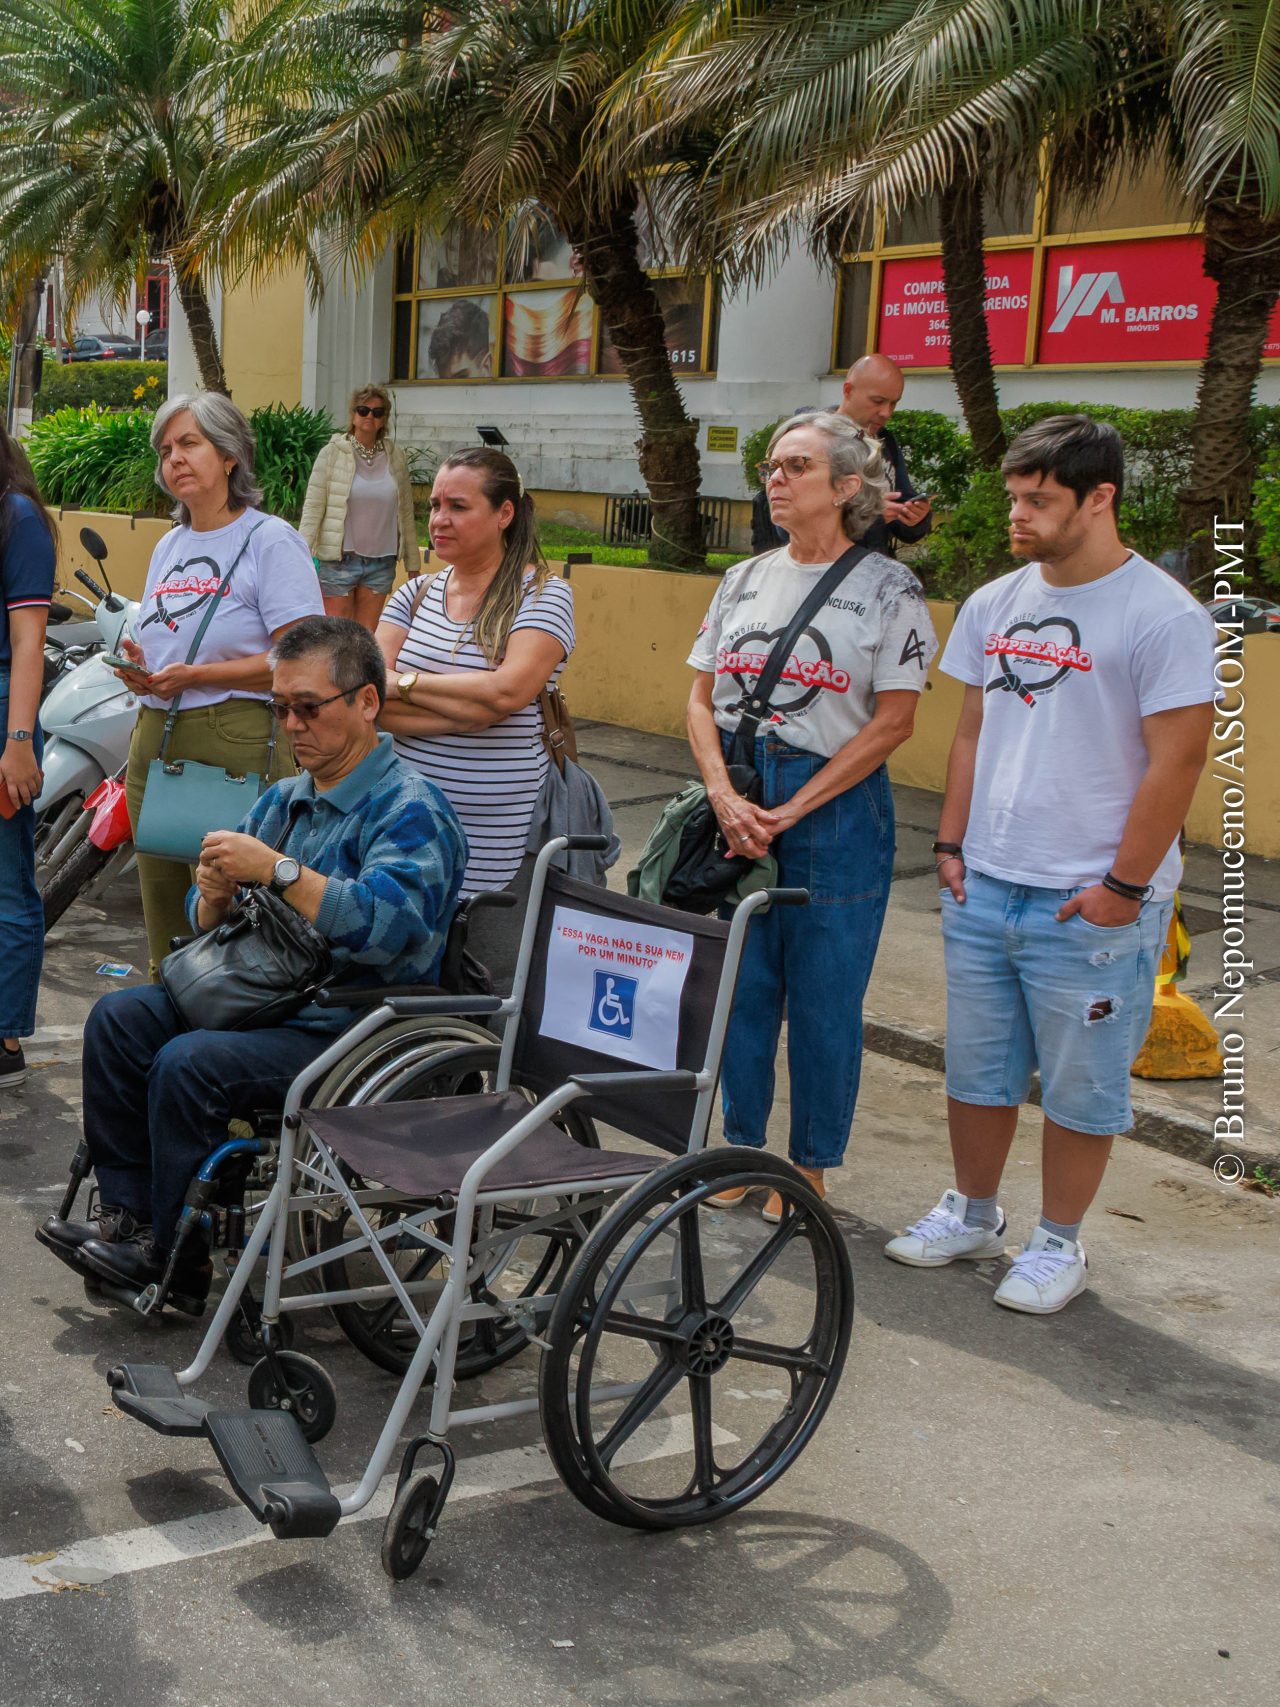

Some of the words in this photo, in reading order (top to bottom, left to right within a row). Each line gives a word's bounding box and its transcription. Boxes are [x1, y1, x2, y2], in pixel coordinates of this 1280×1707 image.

[904, 281, 946, 296] COMPR
[885, 304, 900, 317] DE
[1100, 308, 1120, 324] M.
[1124, 304, 1199, 323] BARROS
[928, 319, 951, 331] 364
[1126, 323, 1160, 333] IMÓVEIS
[152, 576, 231, 597] SUPERAÇÃ
[729, 622, 767, 642] PROJETO
[984, 633, 1092, 672] SUPERAÇÃO
[578, 944, 597, 957] POR
[599, 950, 615, 961] UM
[585, 933, 610, 946] VAGA
[612, 937, 633, 950] NÃO
[635, 940, 642, 952] É
[645, 944, 663, 957] SUA
[665, 950, 685, 962] NEM
